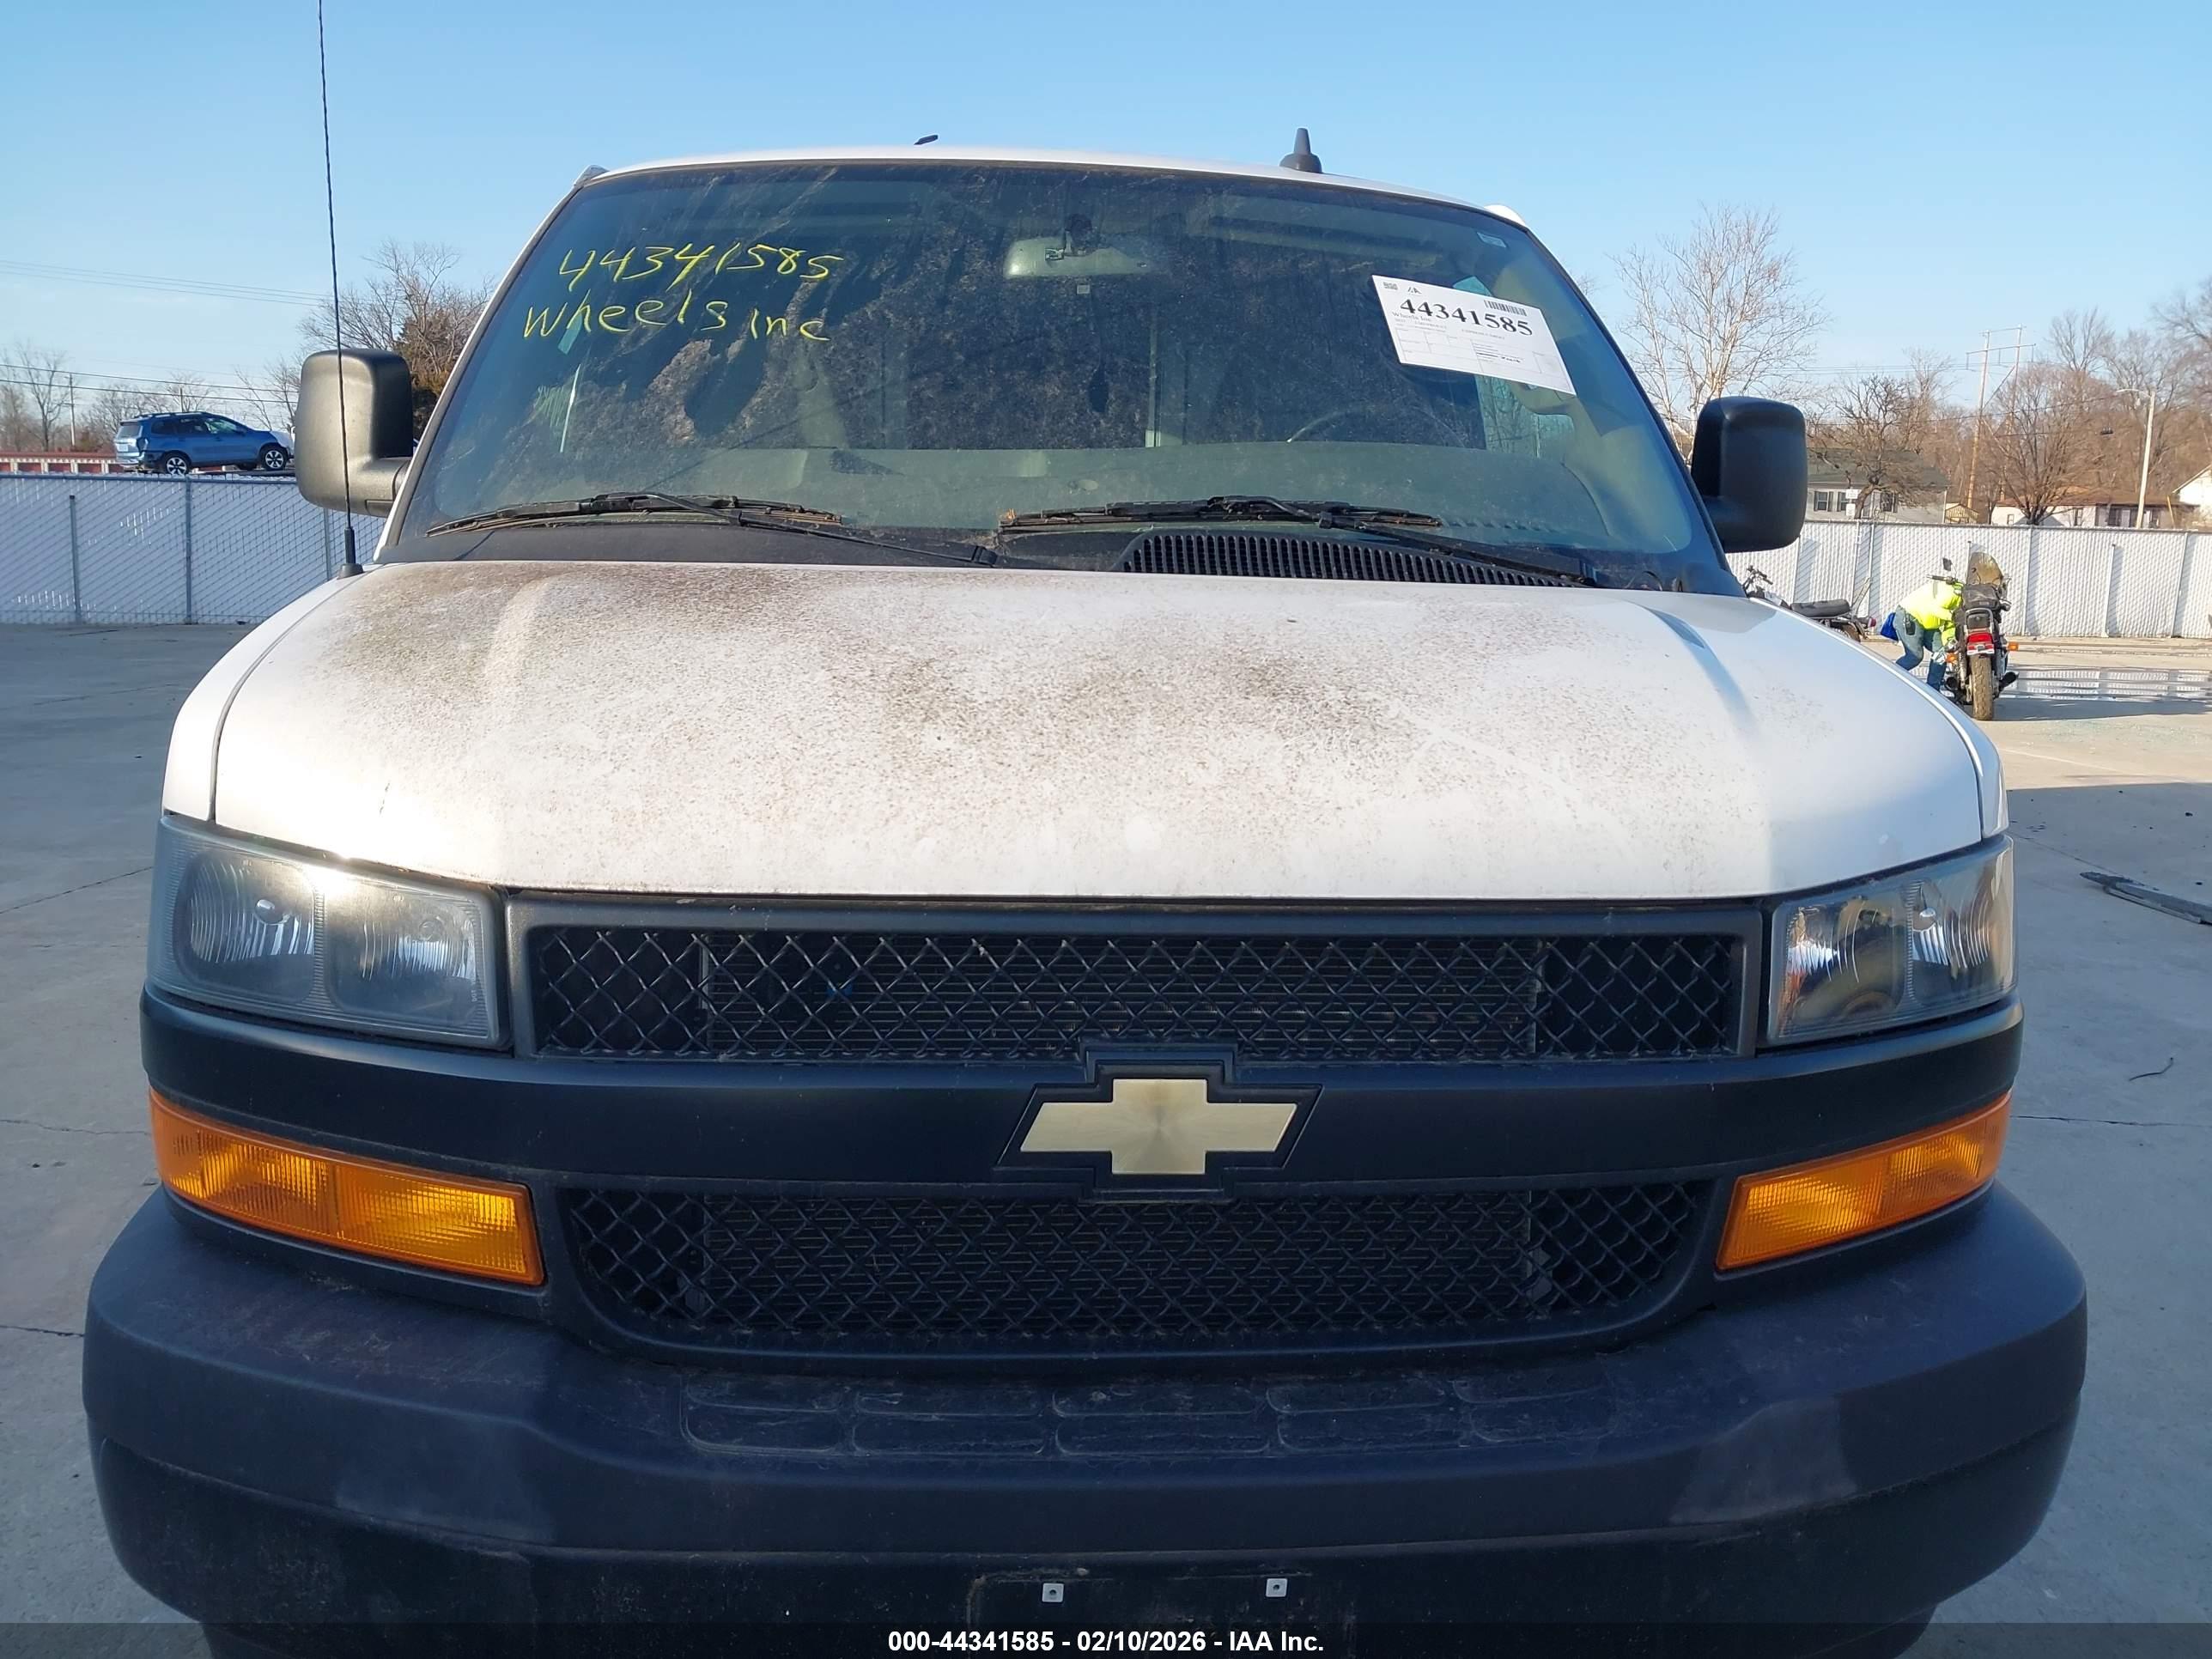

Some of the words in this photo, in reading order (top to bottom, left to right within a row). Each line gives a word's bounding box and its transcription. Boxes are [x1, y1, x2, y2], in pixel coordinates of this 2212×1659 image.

[559, 242, 845, 292] 44341585
[750, 308, 830, 340] Inc
[1401, 299, 1533, 336] 44341585
